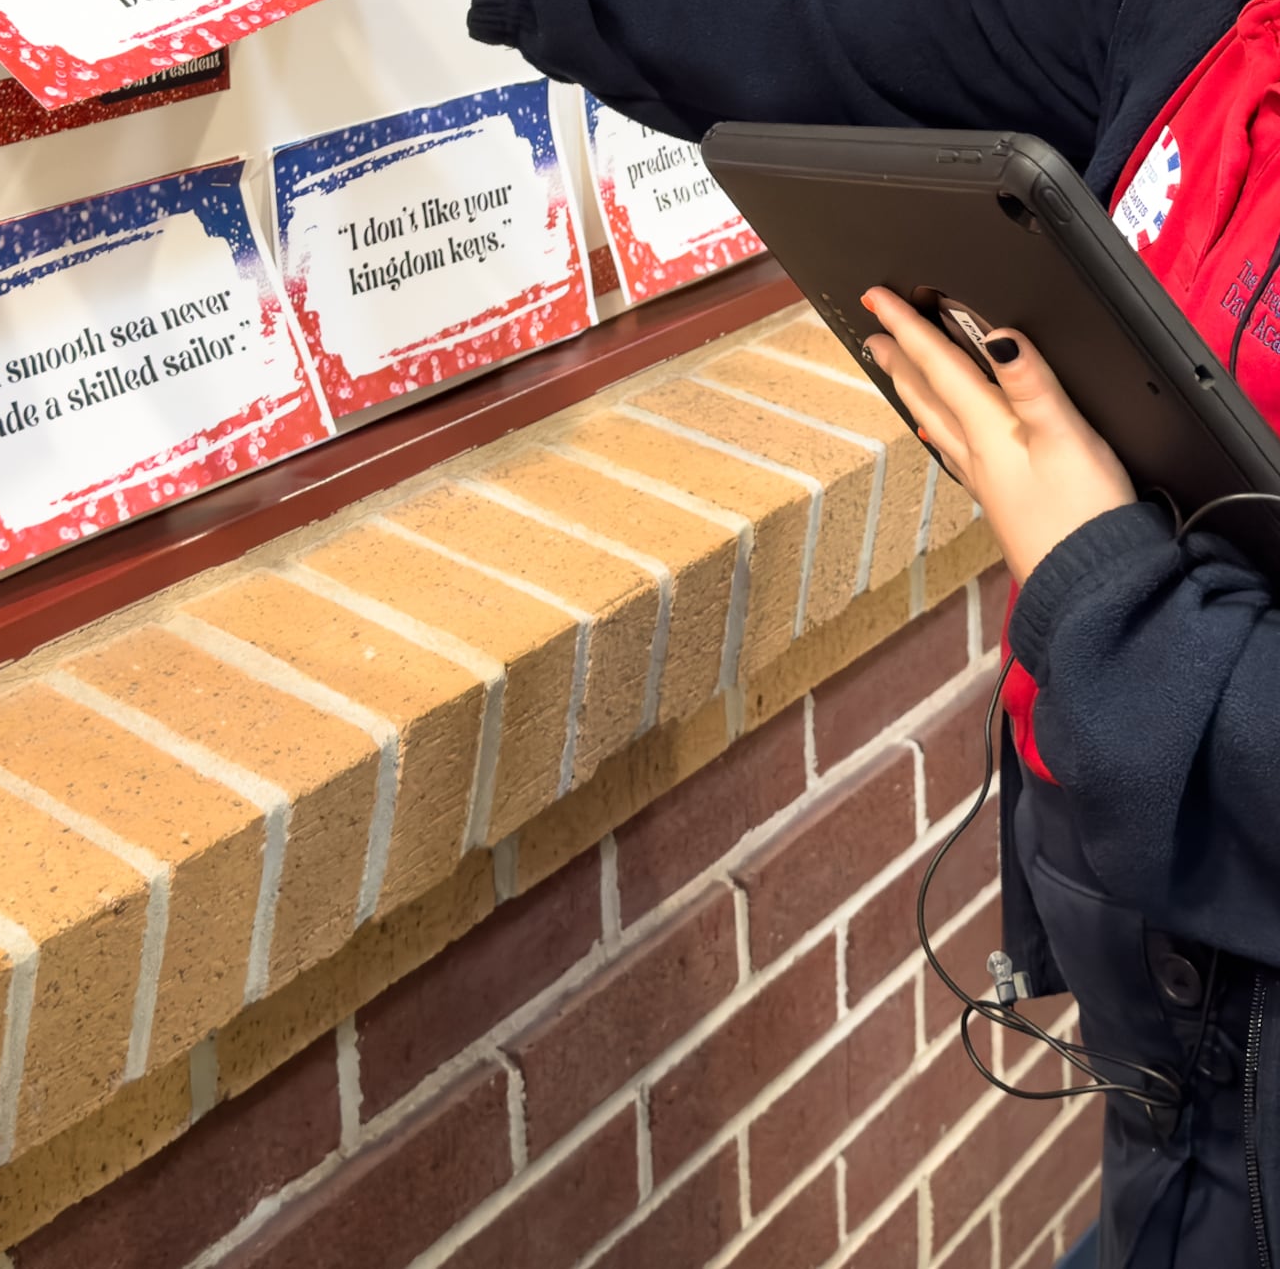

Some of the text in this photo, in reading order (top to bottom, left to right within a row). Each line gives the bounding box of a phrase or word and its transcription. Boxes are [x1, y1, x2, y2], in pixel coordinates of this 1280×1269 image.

[626, 144, 686, 190] predict
[363, 205, 419, 248] don’t
[420, 197, 461, 229] like
[463, 184, 513, 223] your
[652, 176, 721, 212] is to cre
[348, 247, 446, 296] kingdom
[1236, 259, 1259, 292] The
[5, 327, 107, 384] smooth
[109, 314, 159, 349] sea
[160, 289, 232, 331] never
[961, 320, 986, 349] IPA
[45, 396, 63, 420] a
[67, 354, 160, 412] skilled
